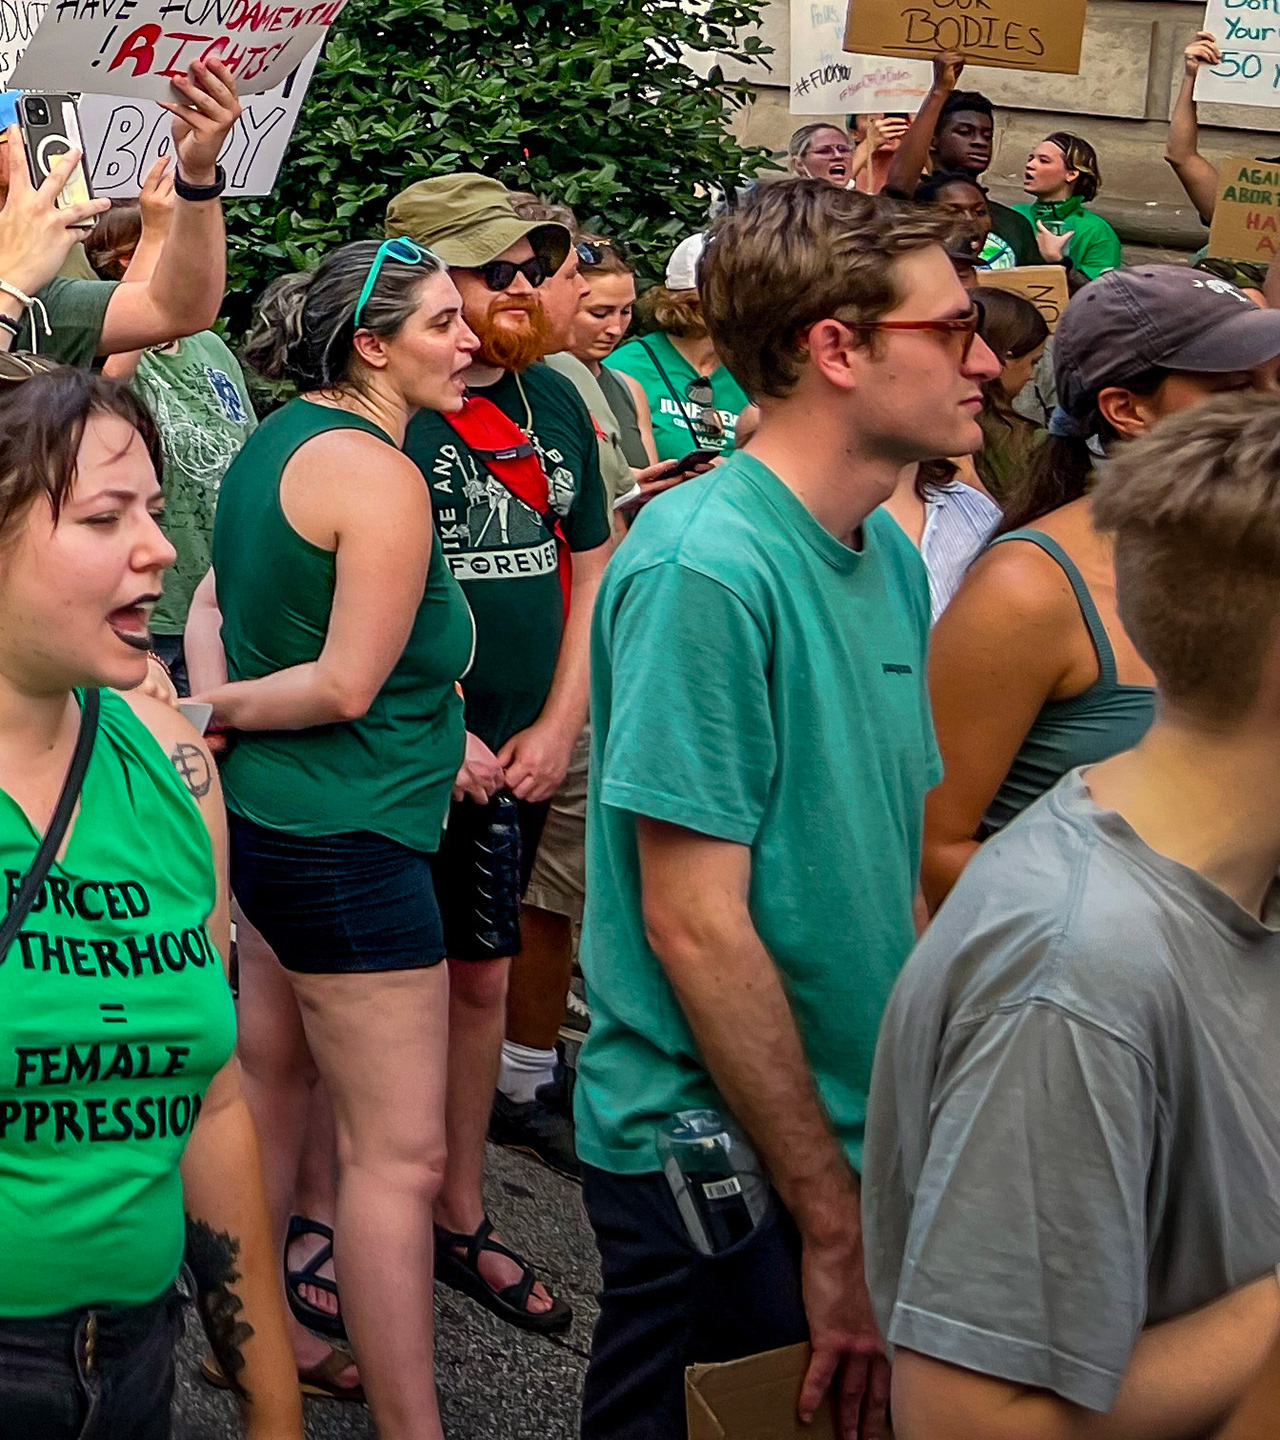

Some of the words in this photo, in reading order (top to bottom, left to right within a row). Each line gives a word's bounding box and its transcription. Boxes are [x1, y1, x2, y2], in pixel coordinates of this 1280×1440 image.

[900, 7, 1045, 56] BODIES
[1224, 16, 1276, 41] Your
[1209, 51, 1262, 79] 50
[433, 444, 457, 494] AND
[13, 1043, 191, 1089] FEMALE
